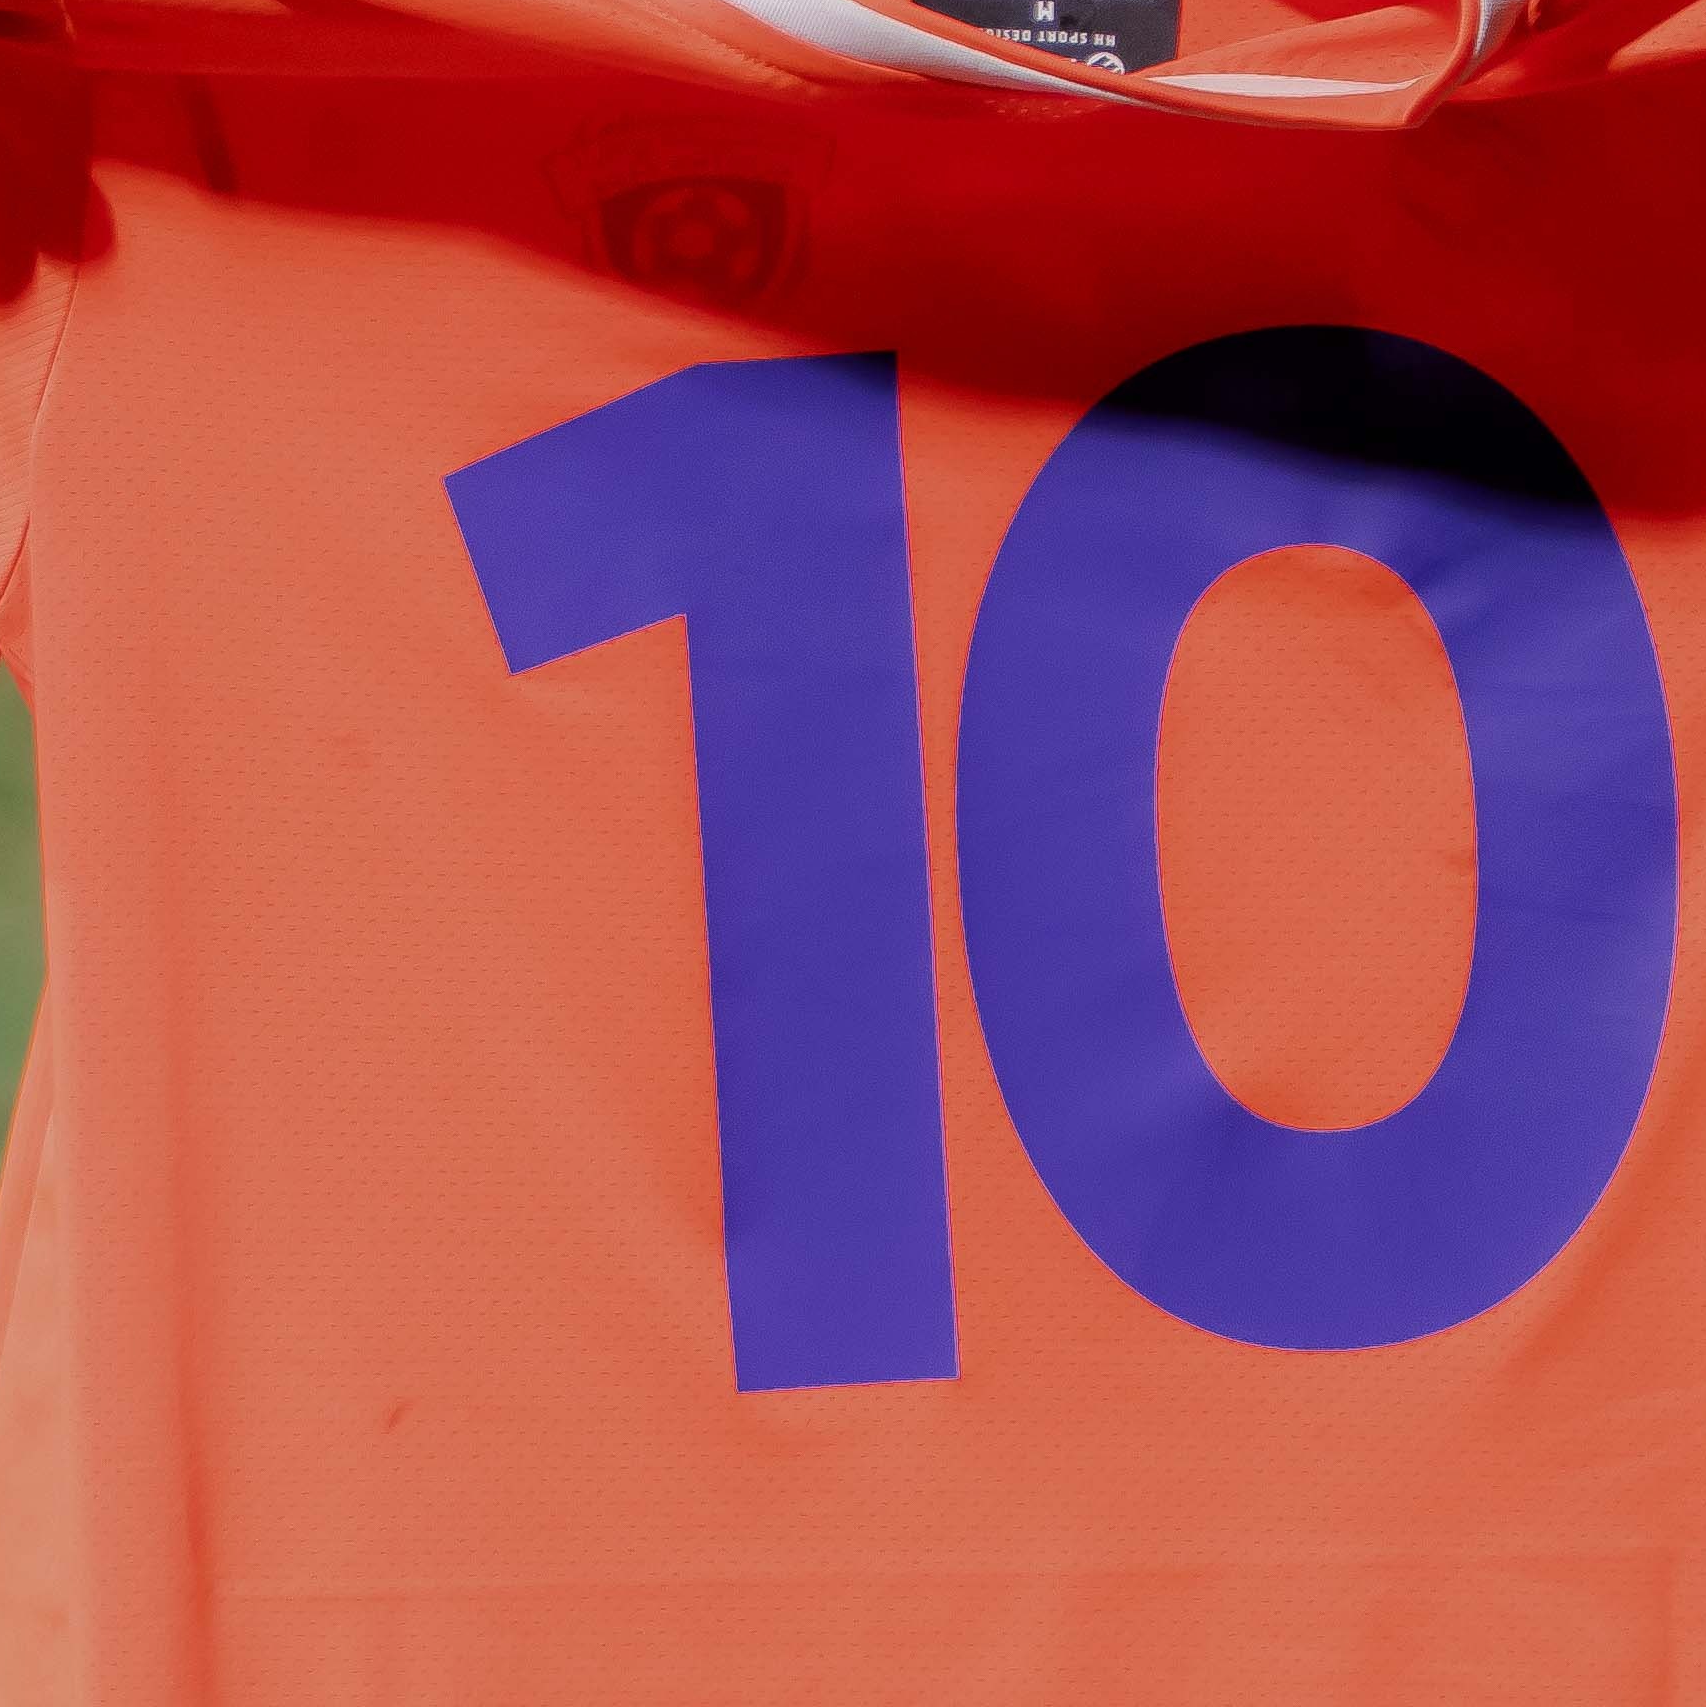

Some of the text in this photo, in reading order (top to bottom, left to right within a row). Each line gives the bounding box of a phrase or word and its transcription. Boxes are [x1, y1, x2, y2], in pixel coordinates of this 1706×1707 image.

[1034, 0, 1055, 22] M
[979, 28, 1031, 42] DESIG
[1037, 30, 1088, 44] SPORT
[443, 324, 1680, 1393] 10
